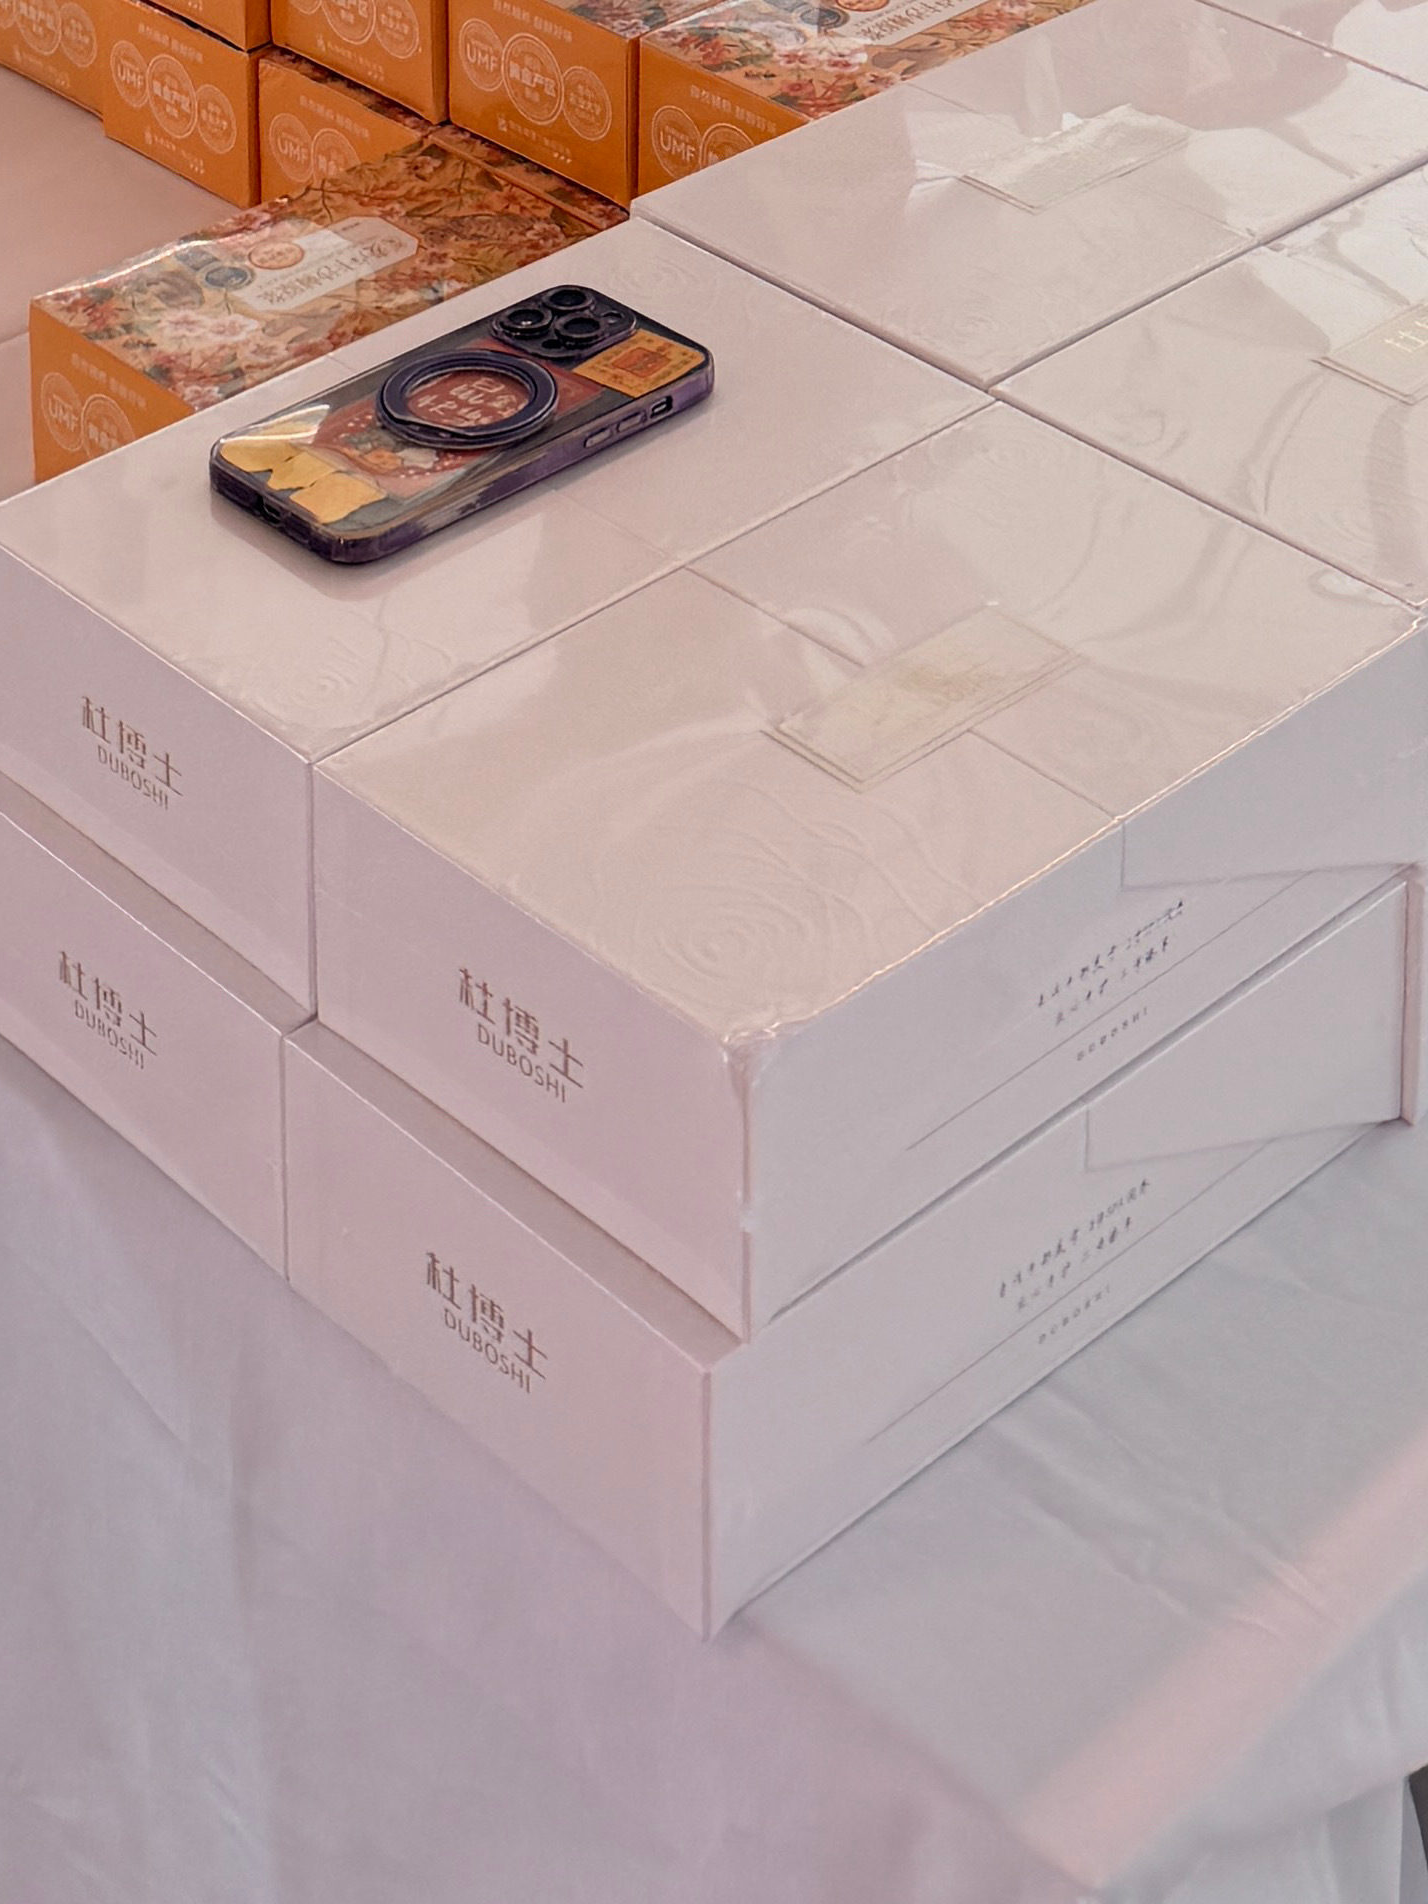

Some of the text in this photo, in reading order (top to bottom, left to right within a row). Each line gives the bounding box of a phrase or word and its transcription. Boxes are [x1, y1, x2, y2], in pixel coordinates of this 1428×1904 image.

[116, 63, 145, 90] UMF
[466, 41, 500, 75] UMF
[277, 136, 309, 162] UMF
[659, 130, 696, 163] UMF
[81, 695, 184, 798] 杜博士
[97, 744, 169, 811] DUBOSHI
[59, 950, 158, 1057] 杜博士
[458, 967, 584, 1089] 杜博士
[477, 1022, 567, 1104] DUBOSHI
[425, 1251, 548, 1380] 杜博士
[443, 1307, 532, 1394] DUBOSHI
